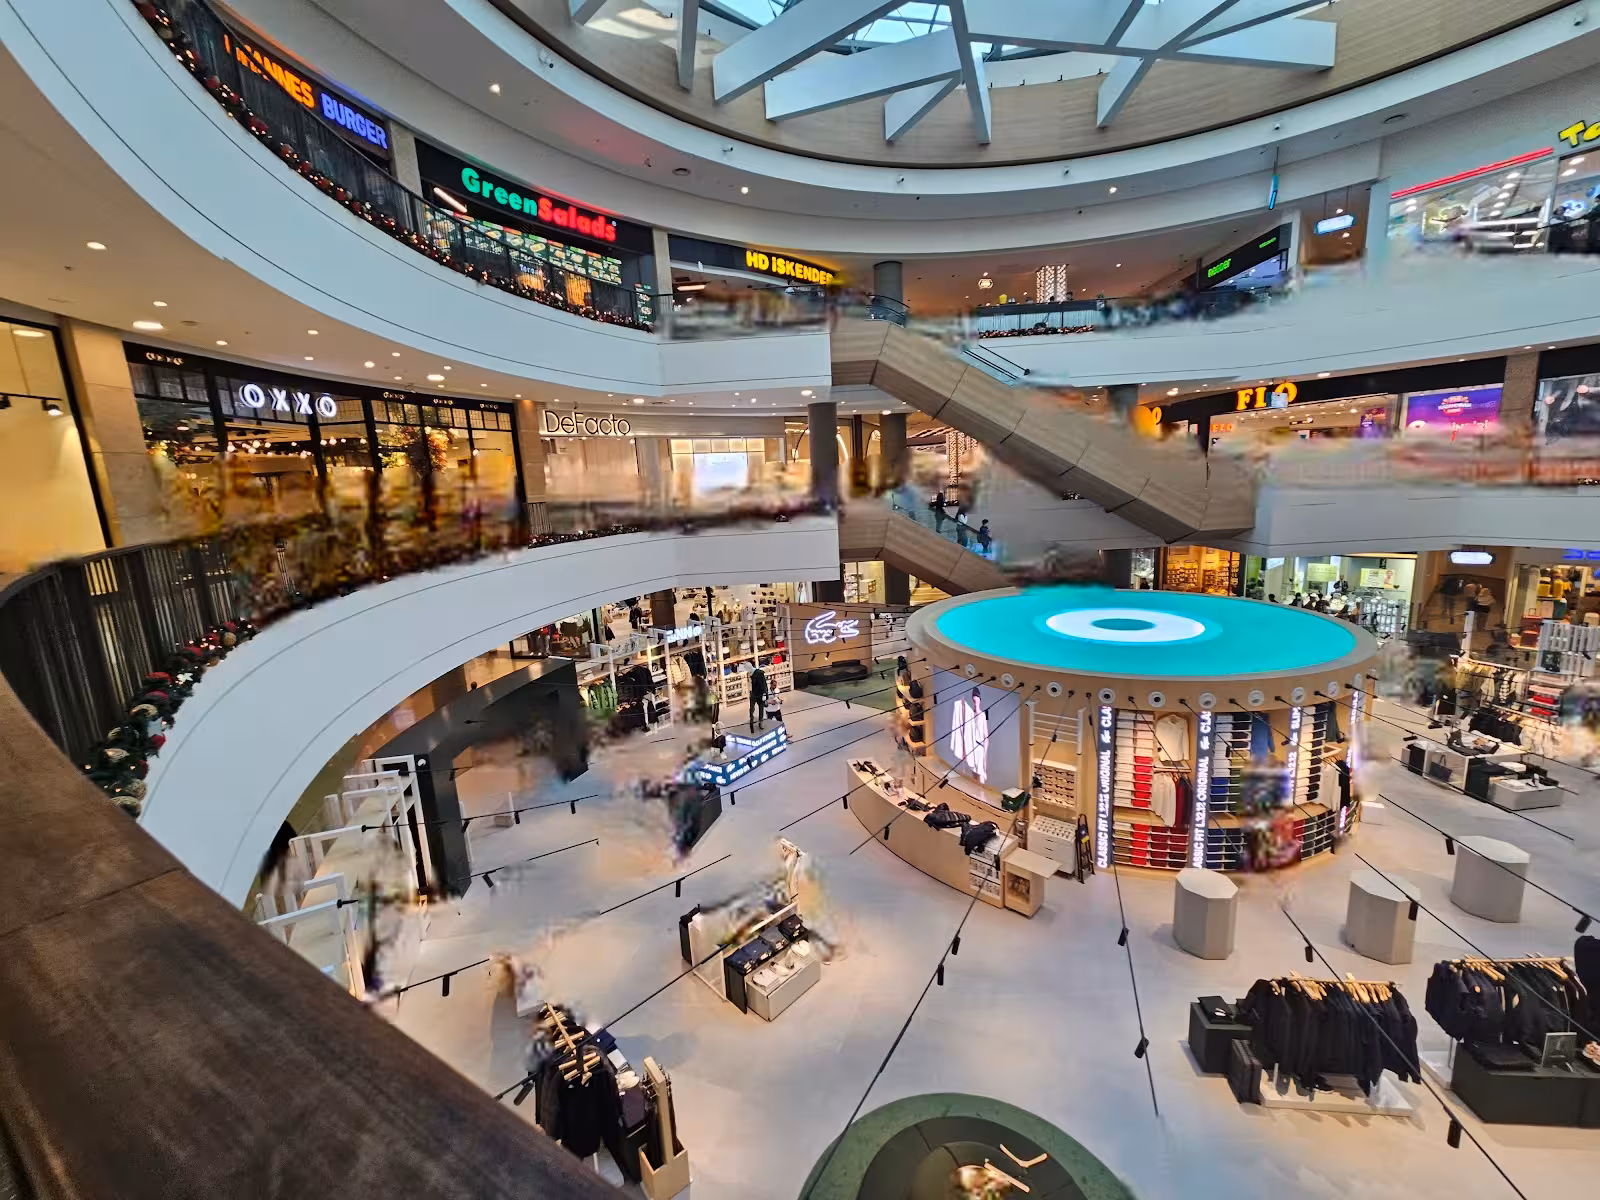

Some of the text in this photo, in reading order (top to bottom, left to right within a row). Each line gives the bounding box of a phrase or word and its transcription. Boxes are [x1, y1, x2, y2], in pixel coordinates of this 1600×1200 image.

[321, 91, 388, 149] BURGER
[461, 167, 616, 242] GreenSalads
[746, 250, 769, 270] HD
[239, 383, 337, 418] OXXO
[543, 410, 631, 435] DeFacto
[1197, 757, 1209, 801] ORIGINAL
[1097, 832, 1109, 868] CLASSIC
